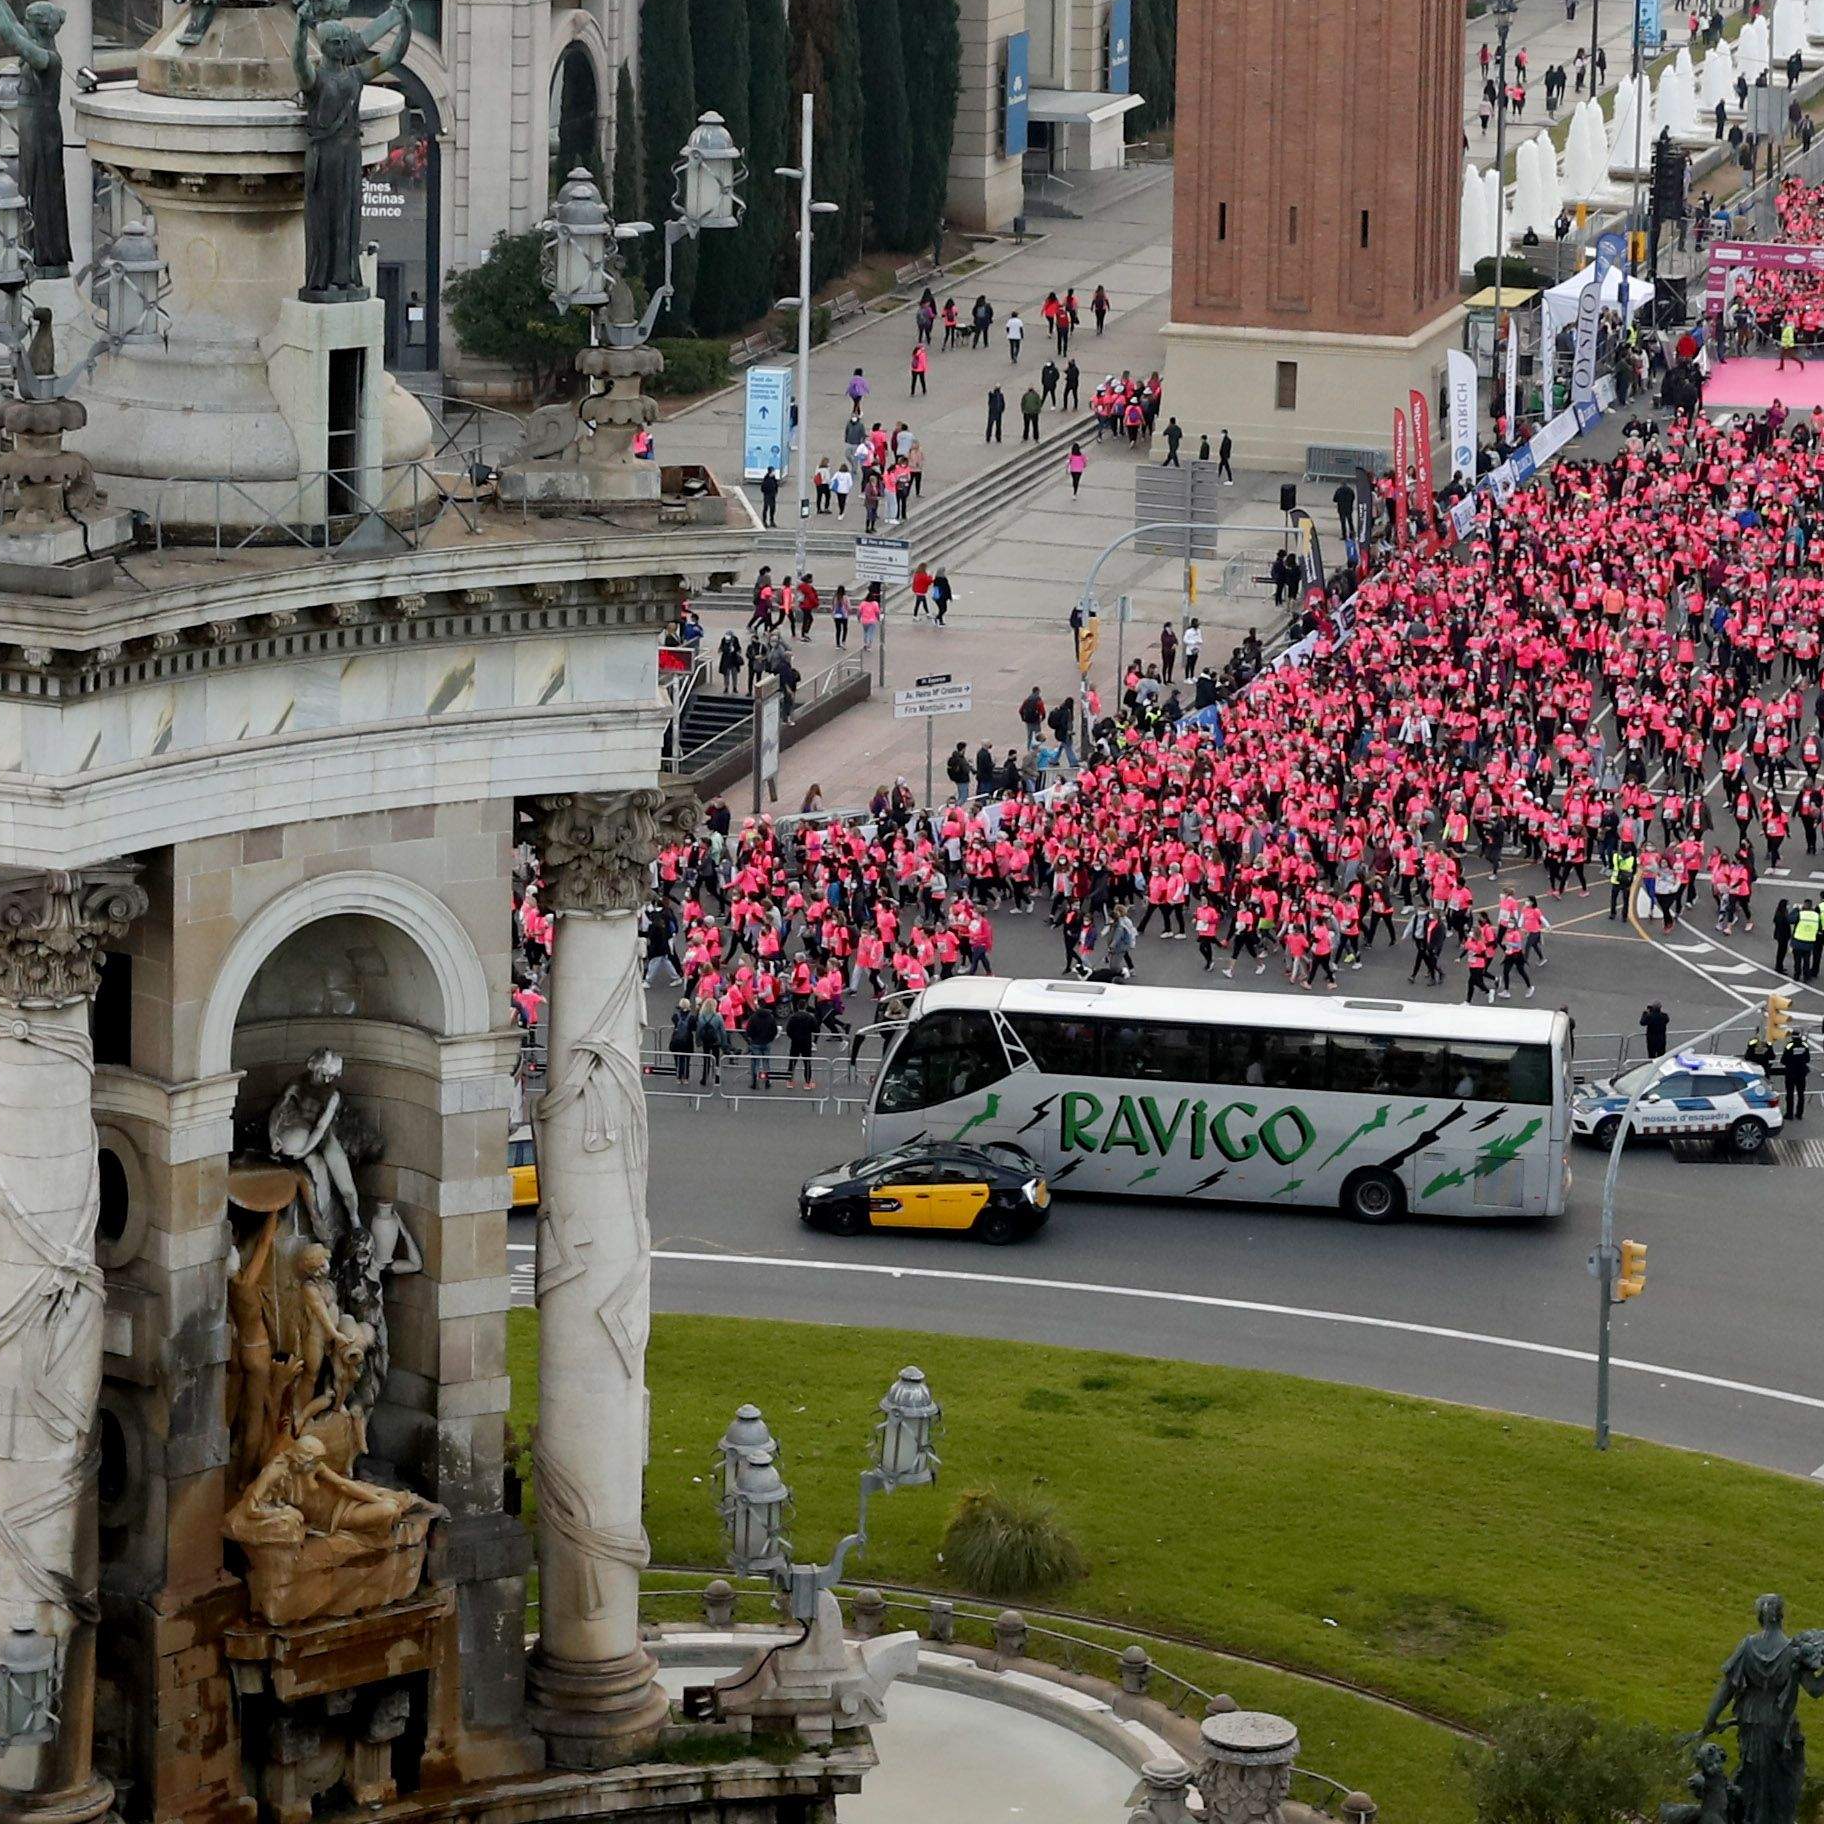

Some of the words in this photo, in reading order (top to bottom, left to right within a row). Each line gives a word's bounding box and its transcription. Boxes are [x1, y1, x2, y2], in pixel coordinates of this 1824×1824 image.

[363, 192, 405, 204] ficinas
[361, 205, 402, 217] trance
[1576, 294, 1597, 388] OYSHO
[1641, 1115, 1677, 1123] mossos
[1680, 1113, 1730, 1123] d'esquadra
